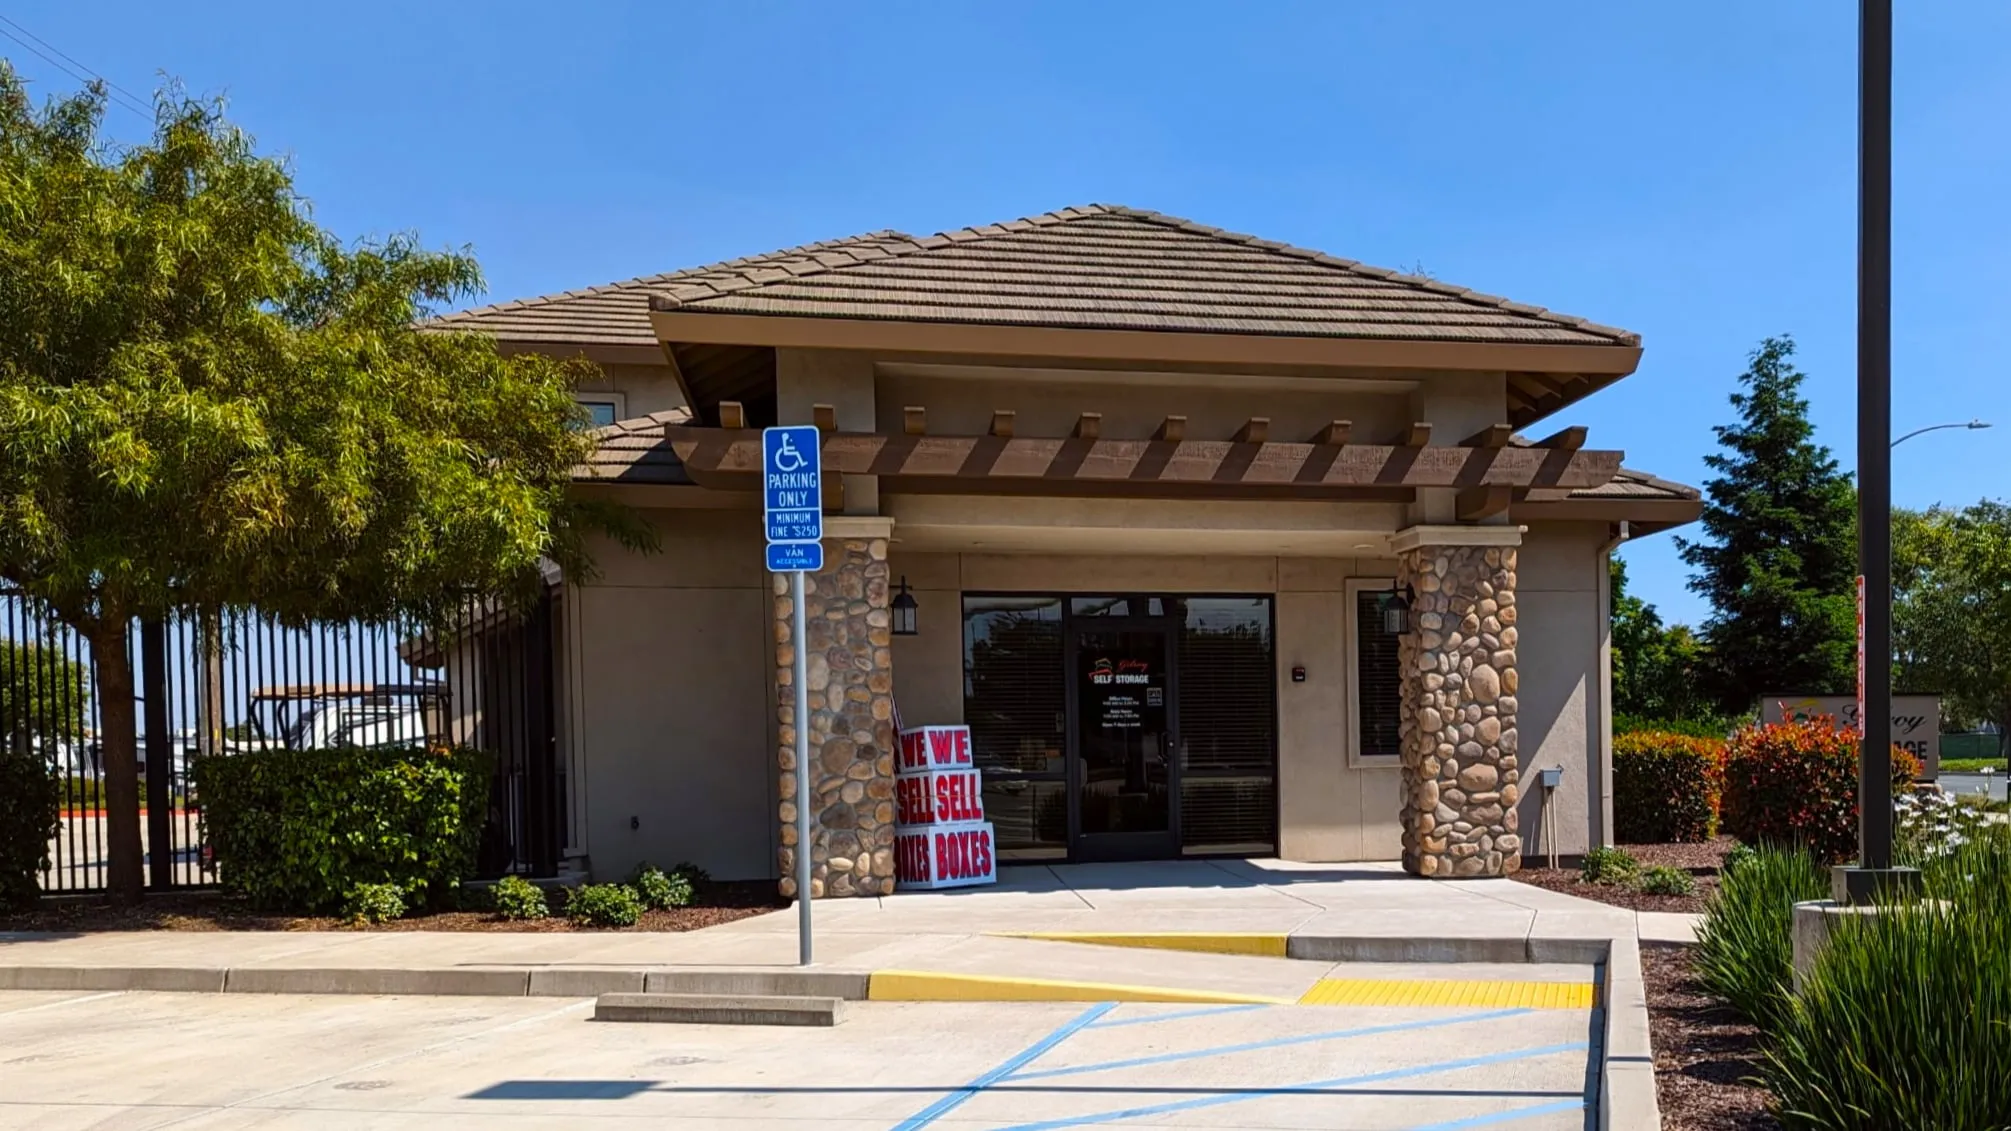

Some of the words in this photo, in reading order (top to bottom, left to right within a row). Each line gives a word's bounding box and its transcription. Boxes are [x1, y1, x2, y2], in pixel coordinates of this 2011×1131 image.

[768, 472, 817, 489] PARKING
[778, 491, 808, 507] ONLY
[776, 512, 811, 524] MINIMUM
[771, 526, 788, 538] FINE
[792, 525, 818, 537] $250
[785, 548, 804, 557] VAN
[1093, 674, 1113, 684] SELF
[1115, 674, 1149, 684] STORAGE
[900, 731, 927, 768] WE
[928, 729, 971, 765] WE
[896, 776, 935, 824] SELL
[935, 773, 983, 822] SELL
[934, 830, 992, 881] BOXES
